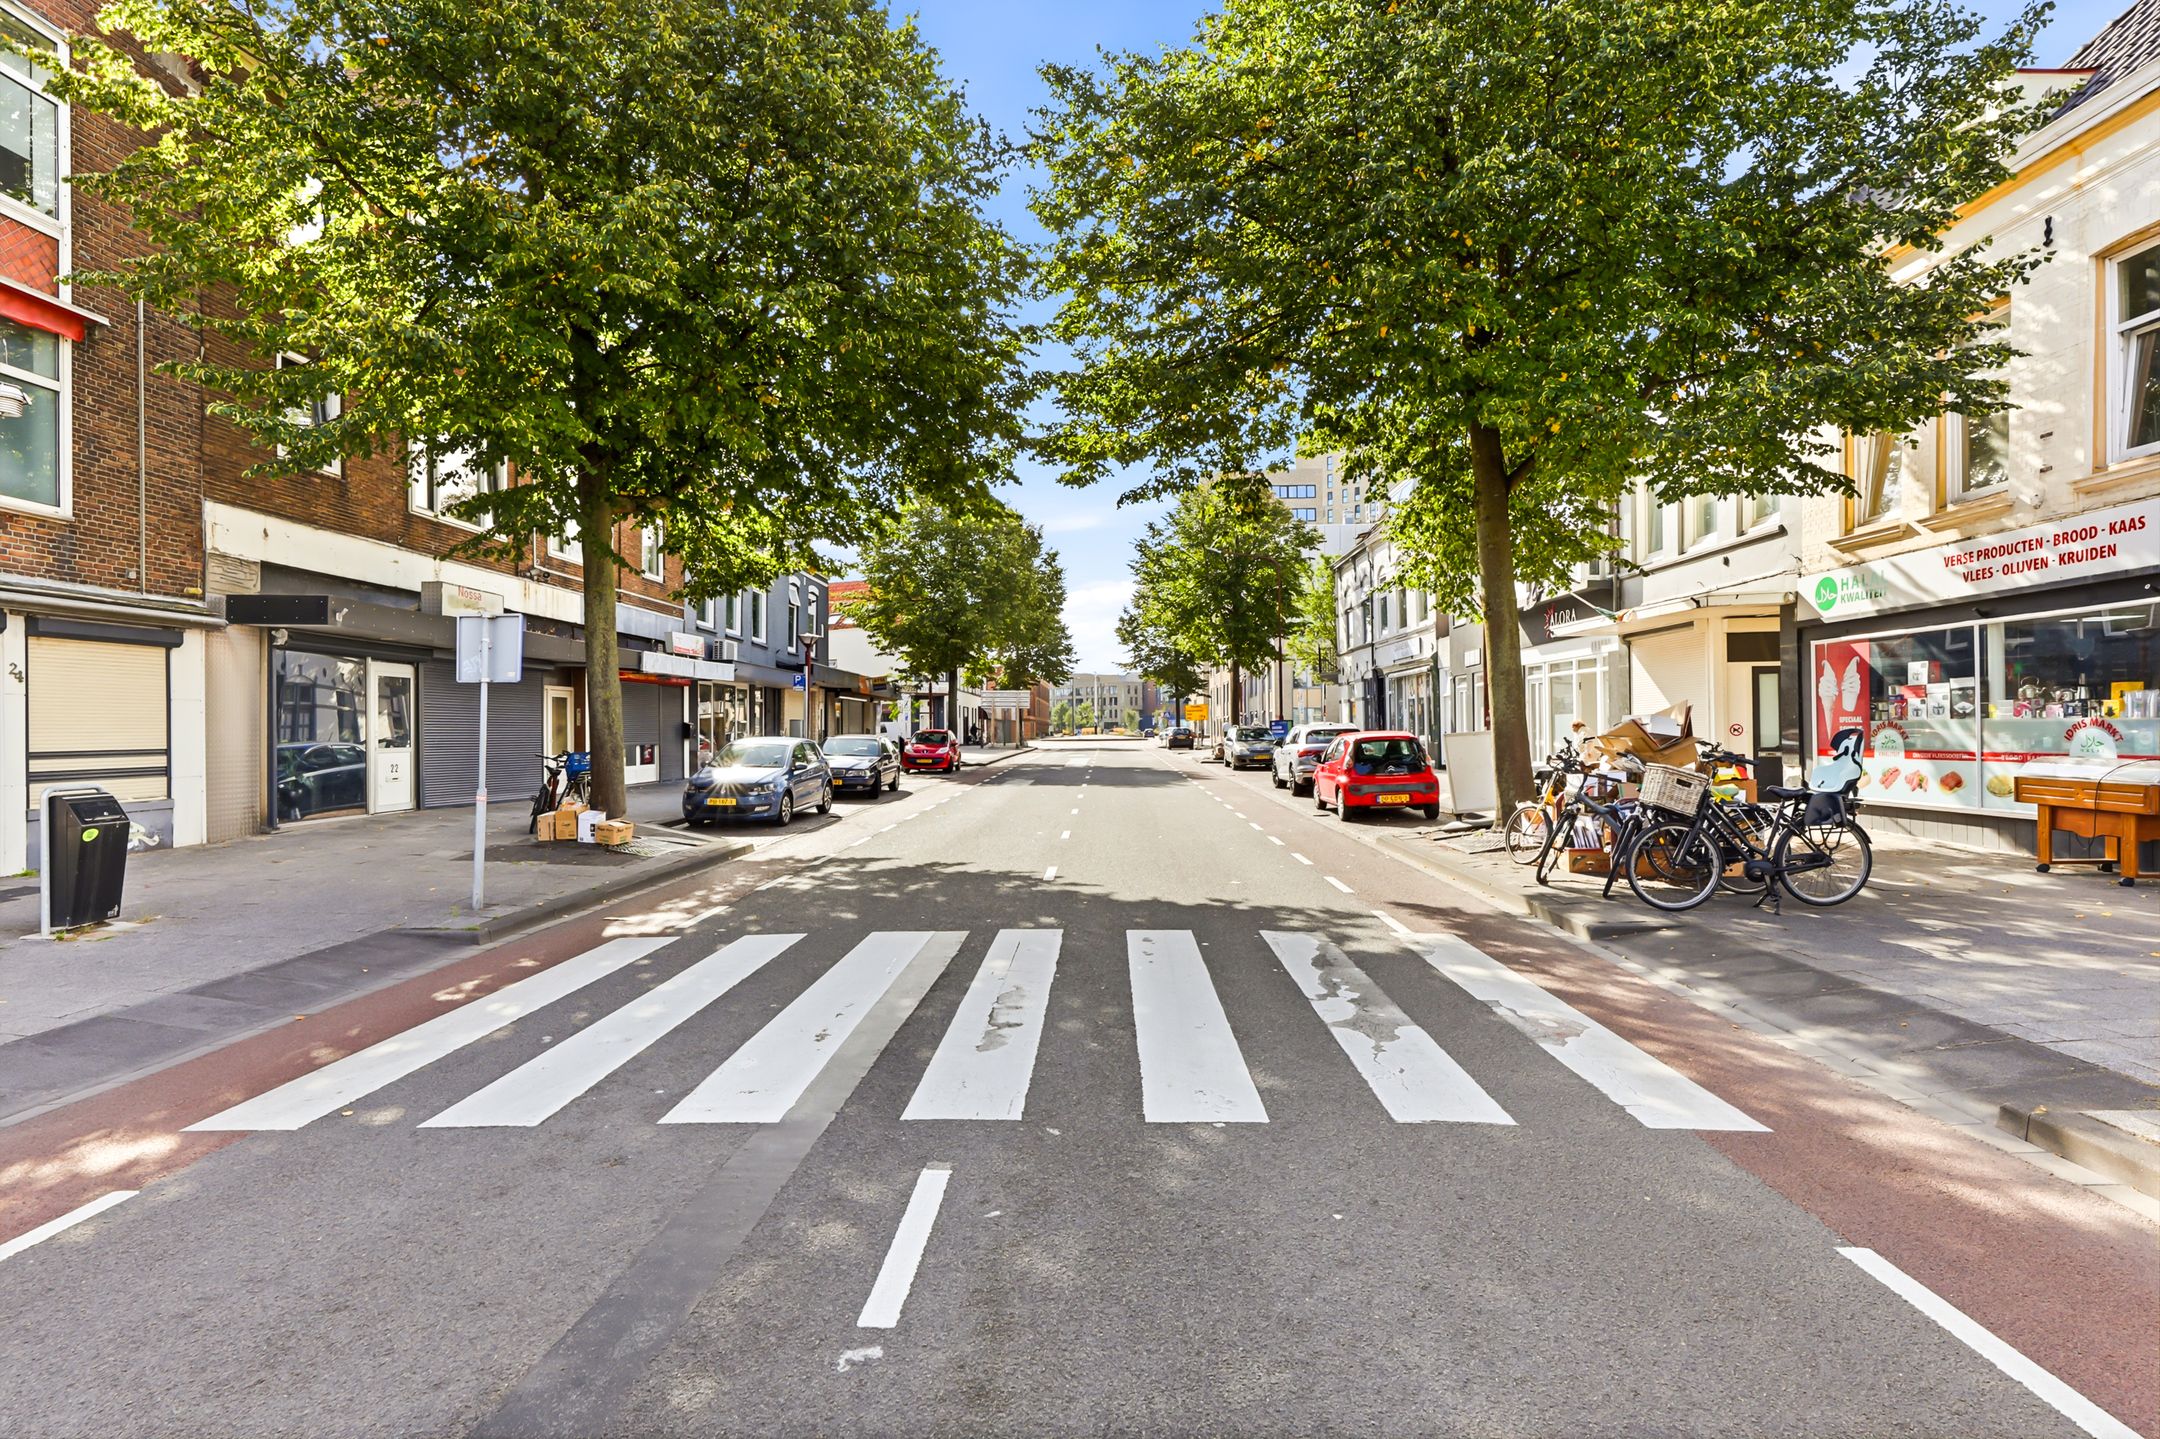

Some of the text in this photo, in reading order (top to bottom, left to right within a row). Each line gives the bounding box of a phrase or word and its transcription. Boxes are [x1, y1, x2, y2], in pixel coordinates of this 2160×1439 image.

[1944, 551, 1974, 568] VERSE
[1977, 537, 2043, 561] PRODUCTEN
[2053, 526, 2098, 546] BROOD
[2109, 516, 2146, 536] KAAS
[1962, 567, 1993, 583] VLEES
[2002, 557, 2049, 576] OLIJVEN
[2058, 544, 2117, 566] KRUIDEN
[458, 585, 482, 601] Nossa
[8, 662, 24, 683] 24
[1887, 721, 1910, 740] MARKT
[2064, 717, 2124, 741] IDRIS MARKT
[390, 763, 399, 773] 22
